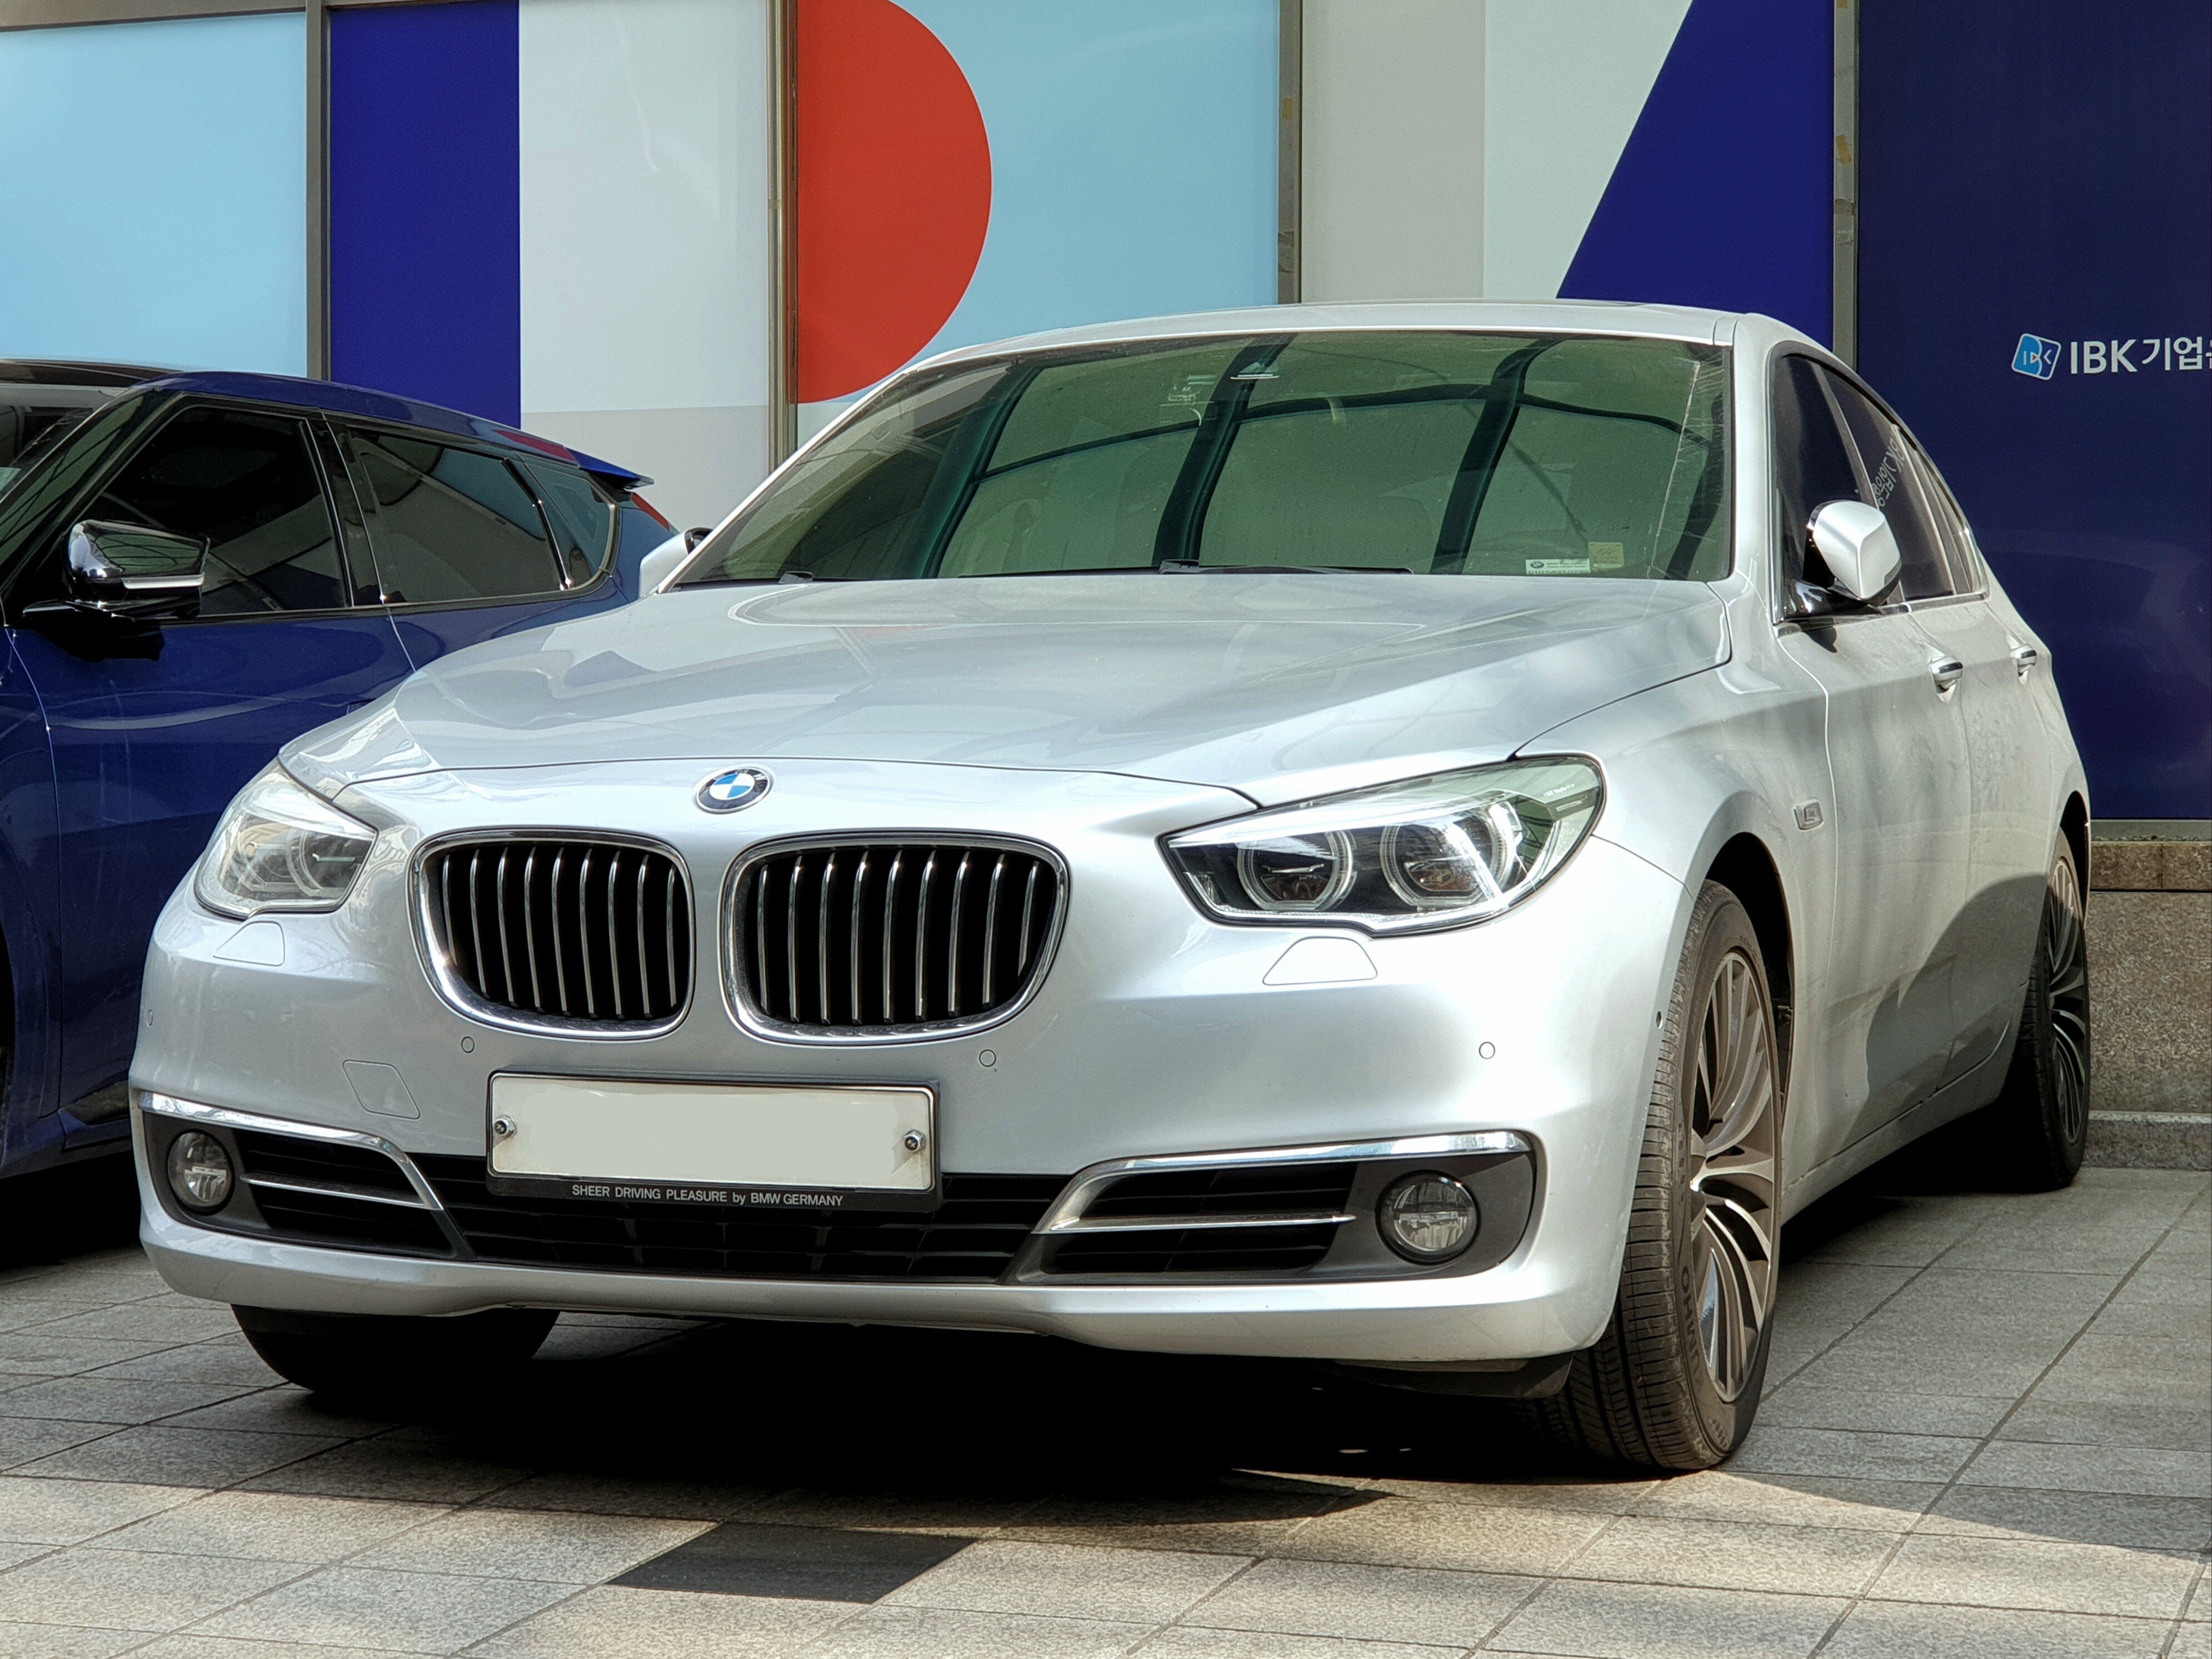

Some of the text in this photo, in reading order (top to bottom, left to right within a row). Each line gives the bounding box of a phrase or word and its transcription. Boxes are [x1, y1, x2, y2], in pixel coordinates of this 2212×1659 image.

[572, 1185, 843, 1207] SHEER DRIVING PLEASURE by BMW GERMANY
